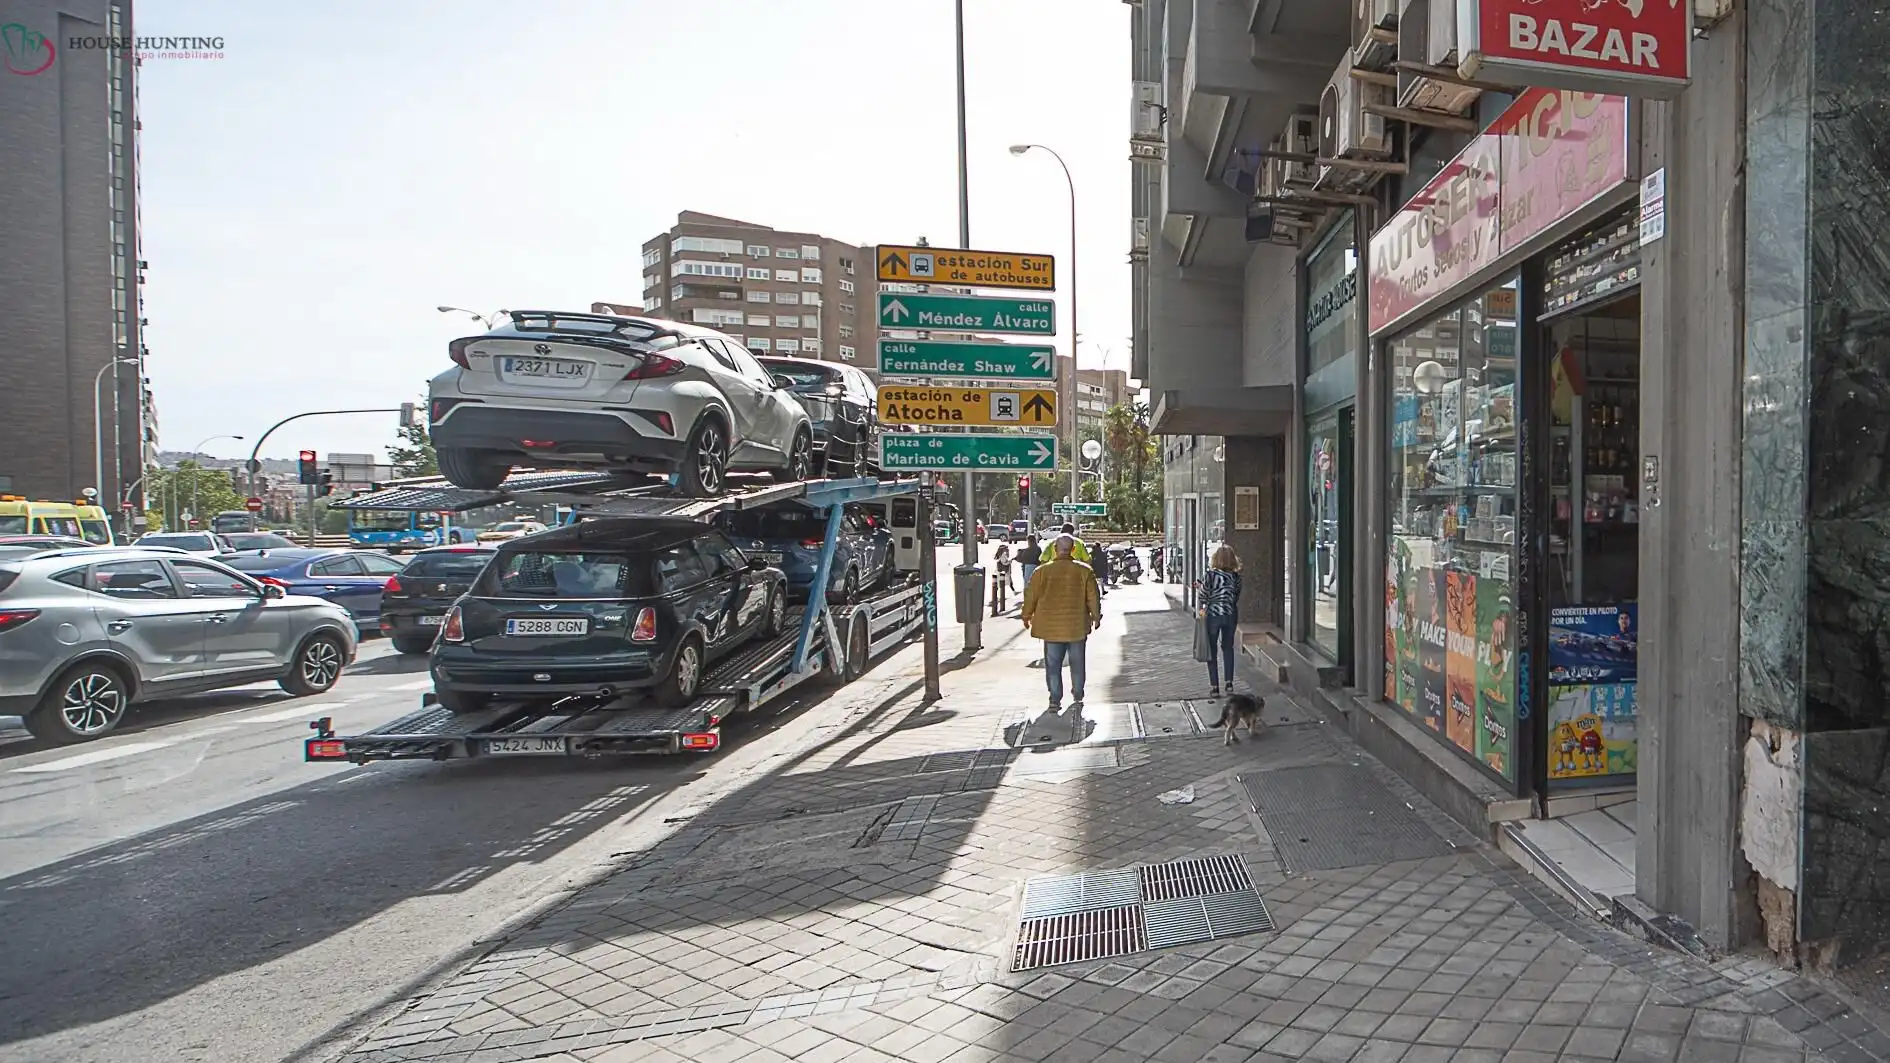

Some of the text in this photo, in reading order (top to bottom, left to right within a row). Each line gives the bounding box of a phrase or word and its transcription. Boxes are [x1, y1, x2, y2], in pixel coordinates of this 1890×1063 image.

[1509, 13, 1660, 69] BAZAR
[937, 256, 1049, 272] estación Sur
[1399, 263, 1428, 298] Frutos
[1433, 235, 1466, 279] Secos
[1473, 225, 1482, 261] y
[951, 270, 1049, 285] de autobuses
[1019, 304, 1049, 313] calle
[918, 311, 1049, 329] Méndez Álvaro
[884, 344, 916, 353] calle
[515, 360, 585, 376] 2371 LJX
[884, 358, 1016, 373] Fernández Shaw
[884, 389, 981, 402] estación de
[885, 403, 963, 421] Atocha
[886, 437, 943, 449] plaza de
[886, 452, 1019, 465] Mariano de Cavia
[1551, 606, 1618, 616] CONVIÉRTETE EN PILOTO
[518, 621, 583, 633] 5288 CGN
[1398, 611, 1419, 637] PLY
[1551, 616, 1565, 625] POR
[1565, 616, 1574, 625] UN
[1420, 620, 1513, 672] MAKE YOUR PLY
[493, 739, 562, 752] 5424 JNX
